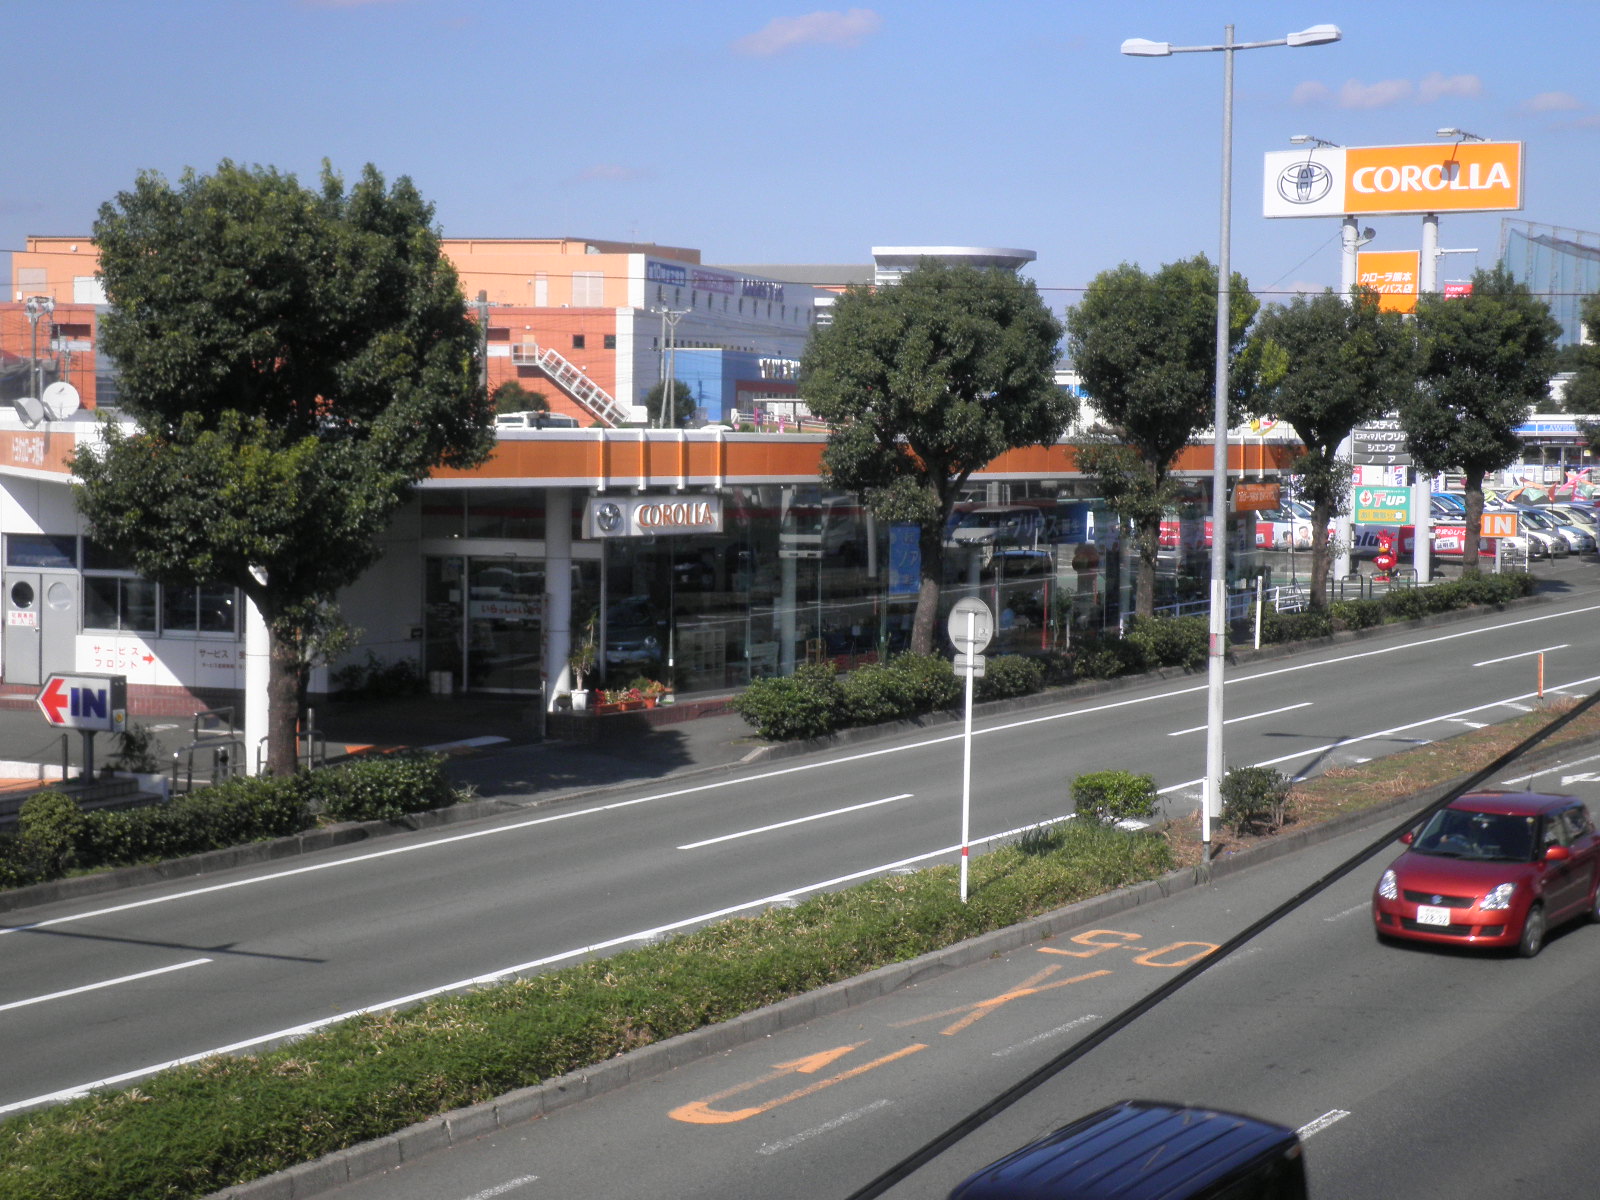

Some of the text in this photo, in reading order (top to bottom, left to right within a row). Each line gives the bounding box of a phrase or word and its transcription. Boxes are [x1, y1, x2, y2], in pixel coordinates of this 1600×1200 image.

[1352, 162, 1511, 194] COROLLA
[1360, 272, 1413, 283] カローラ熊本
[1367, 443, 1396, 452] シエンタ
[1372, 492, 1407, 507] T-UP
[635, 502, 714, 528] COROLLA
[1483, 515, 1512, 535] IN
[94, 644, 140, 656] サービス
[95, 658, 138, 669] フロント
[71, 687, 108, 719] IN
